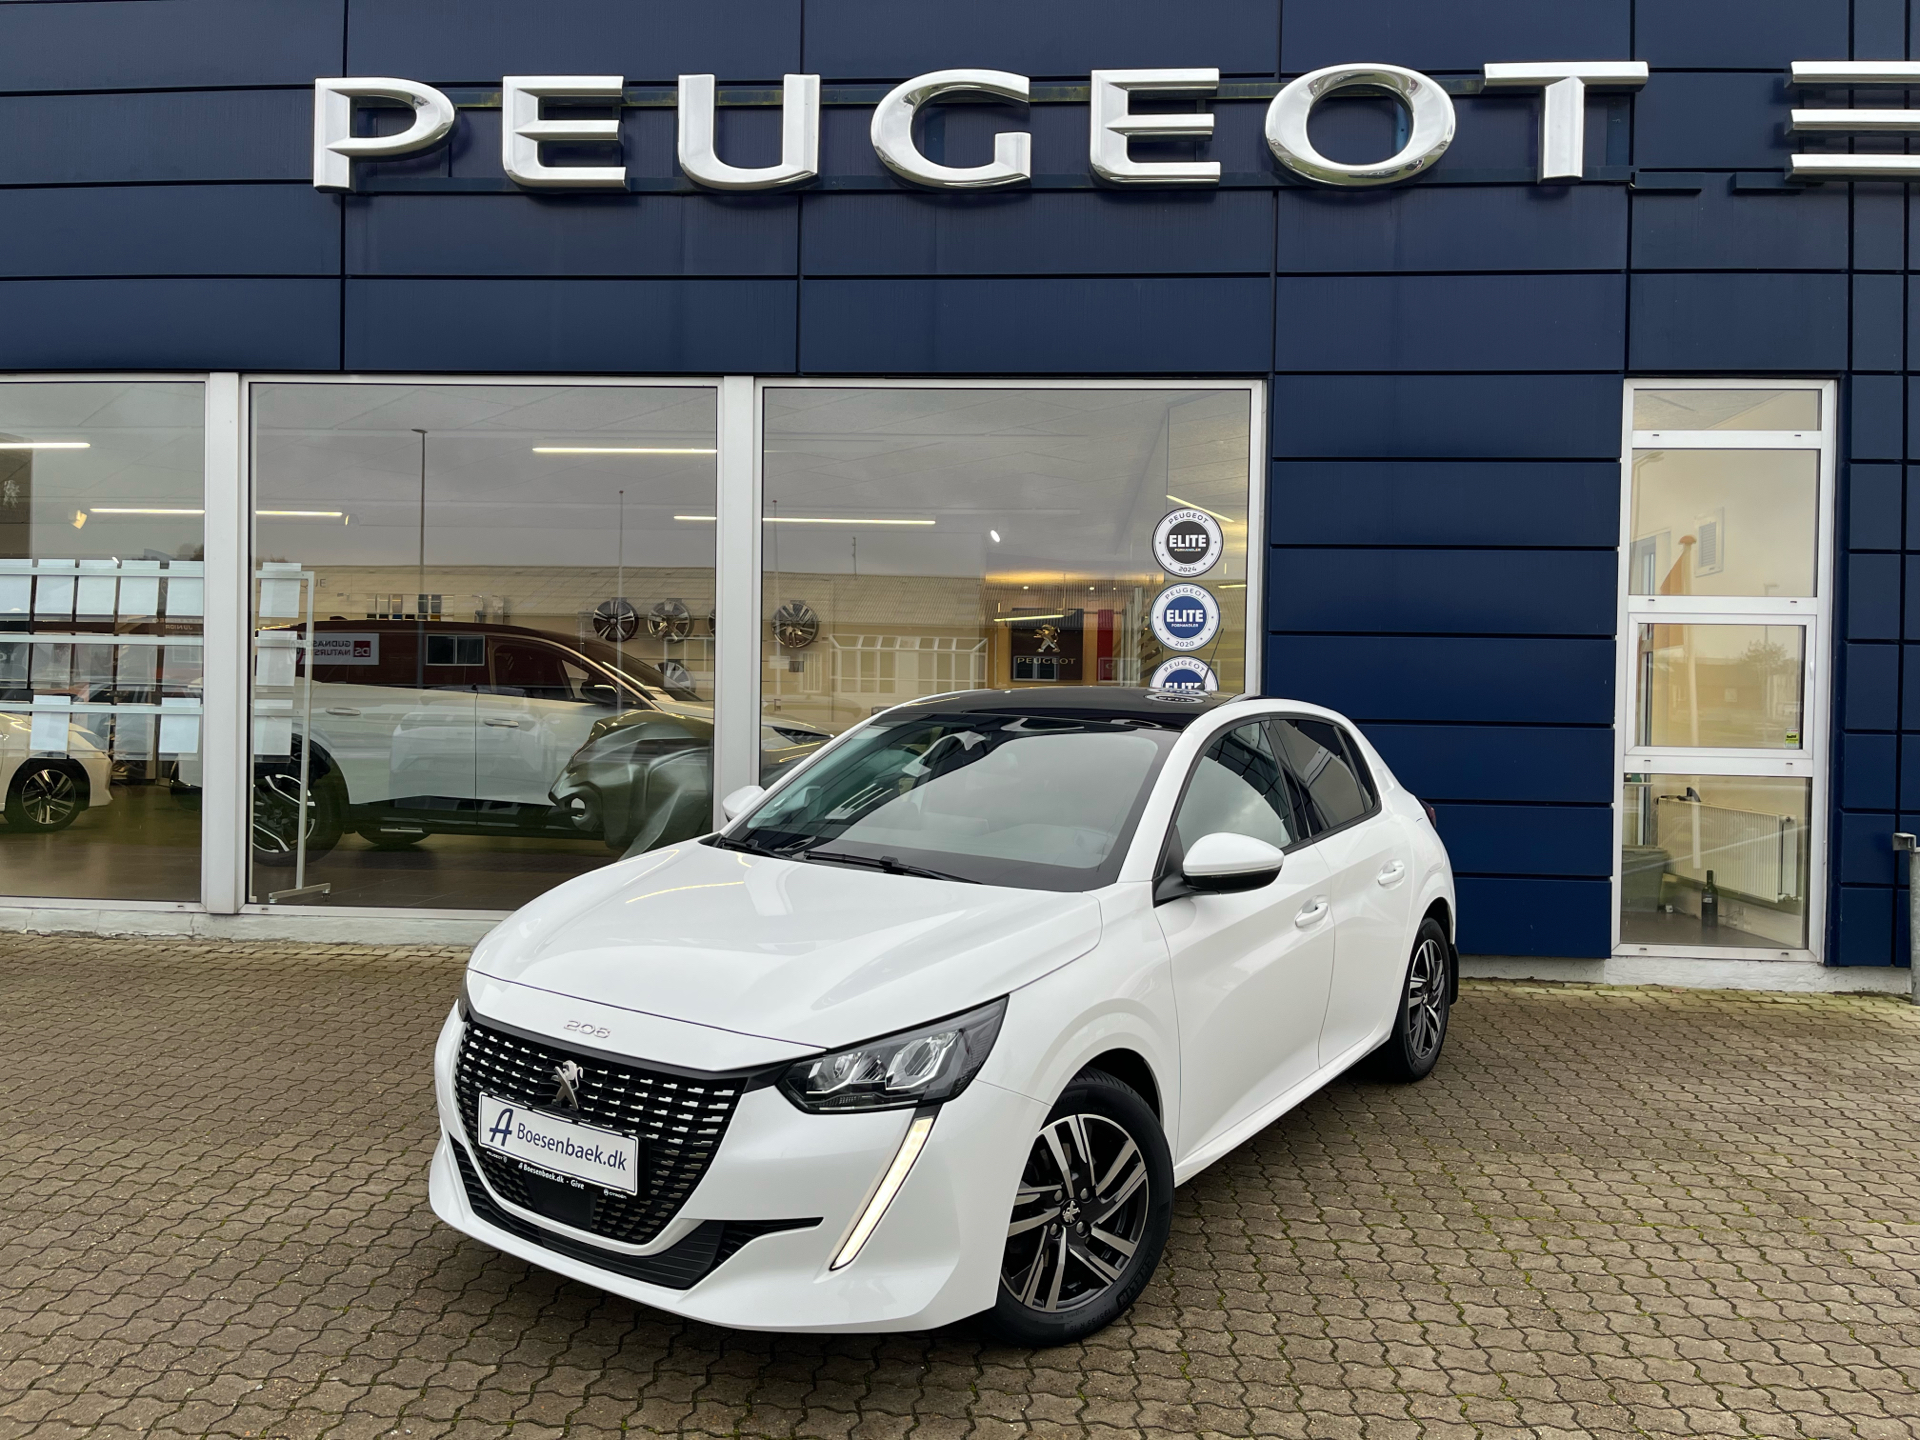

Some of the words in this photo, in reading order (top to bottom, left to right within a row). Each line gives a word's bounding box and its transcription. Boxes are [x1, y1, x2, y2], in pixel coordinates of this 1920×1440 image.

[312, 61, 1651, 193] PEUGEOT
[1168, 511, 1209, 524] PEUGEOT
[1168, 534, 1207, 548] ELITE
[1164, 587, 1207, 600] PEUGEOT
[1166, 609, 1204, 623] ELITE
[1174, 640, 1195, 648] 2020
[1017, 657, 1076, 665] PEUGEOT
[1163, 660, 1205, 673] PEUGEOT
[517, 1122, 627, 1171] Boesenbaek.dk
[523, 1163, 564, 1184] Boesenbaek.dk
[570, 1179, 585, 1190] Give
